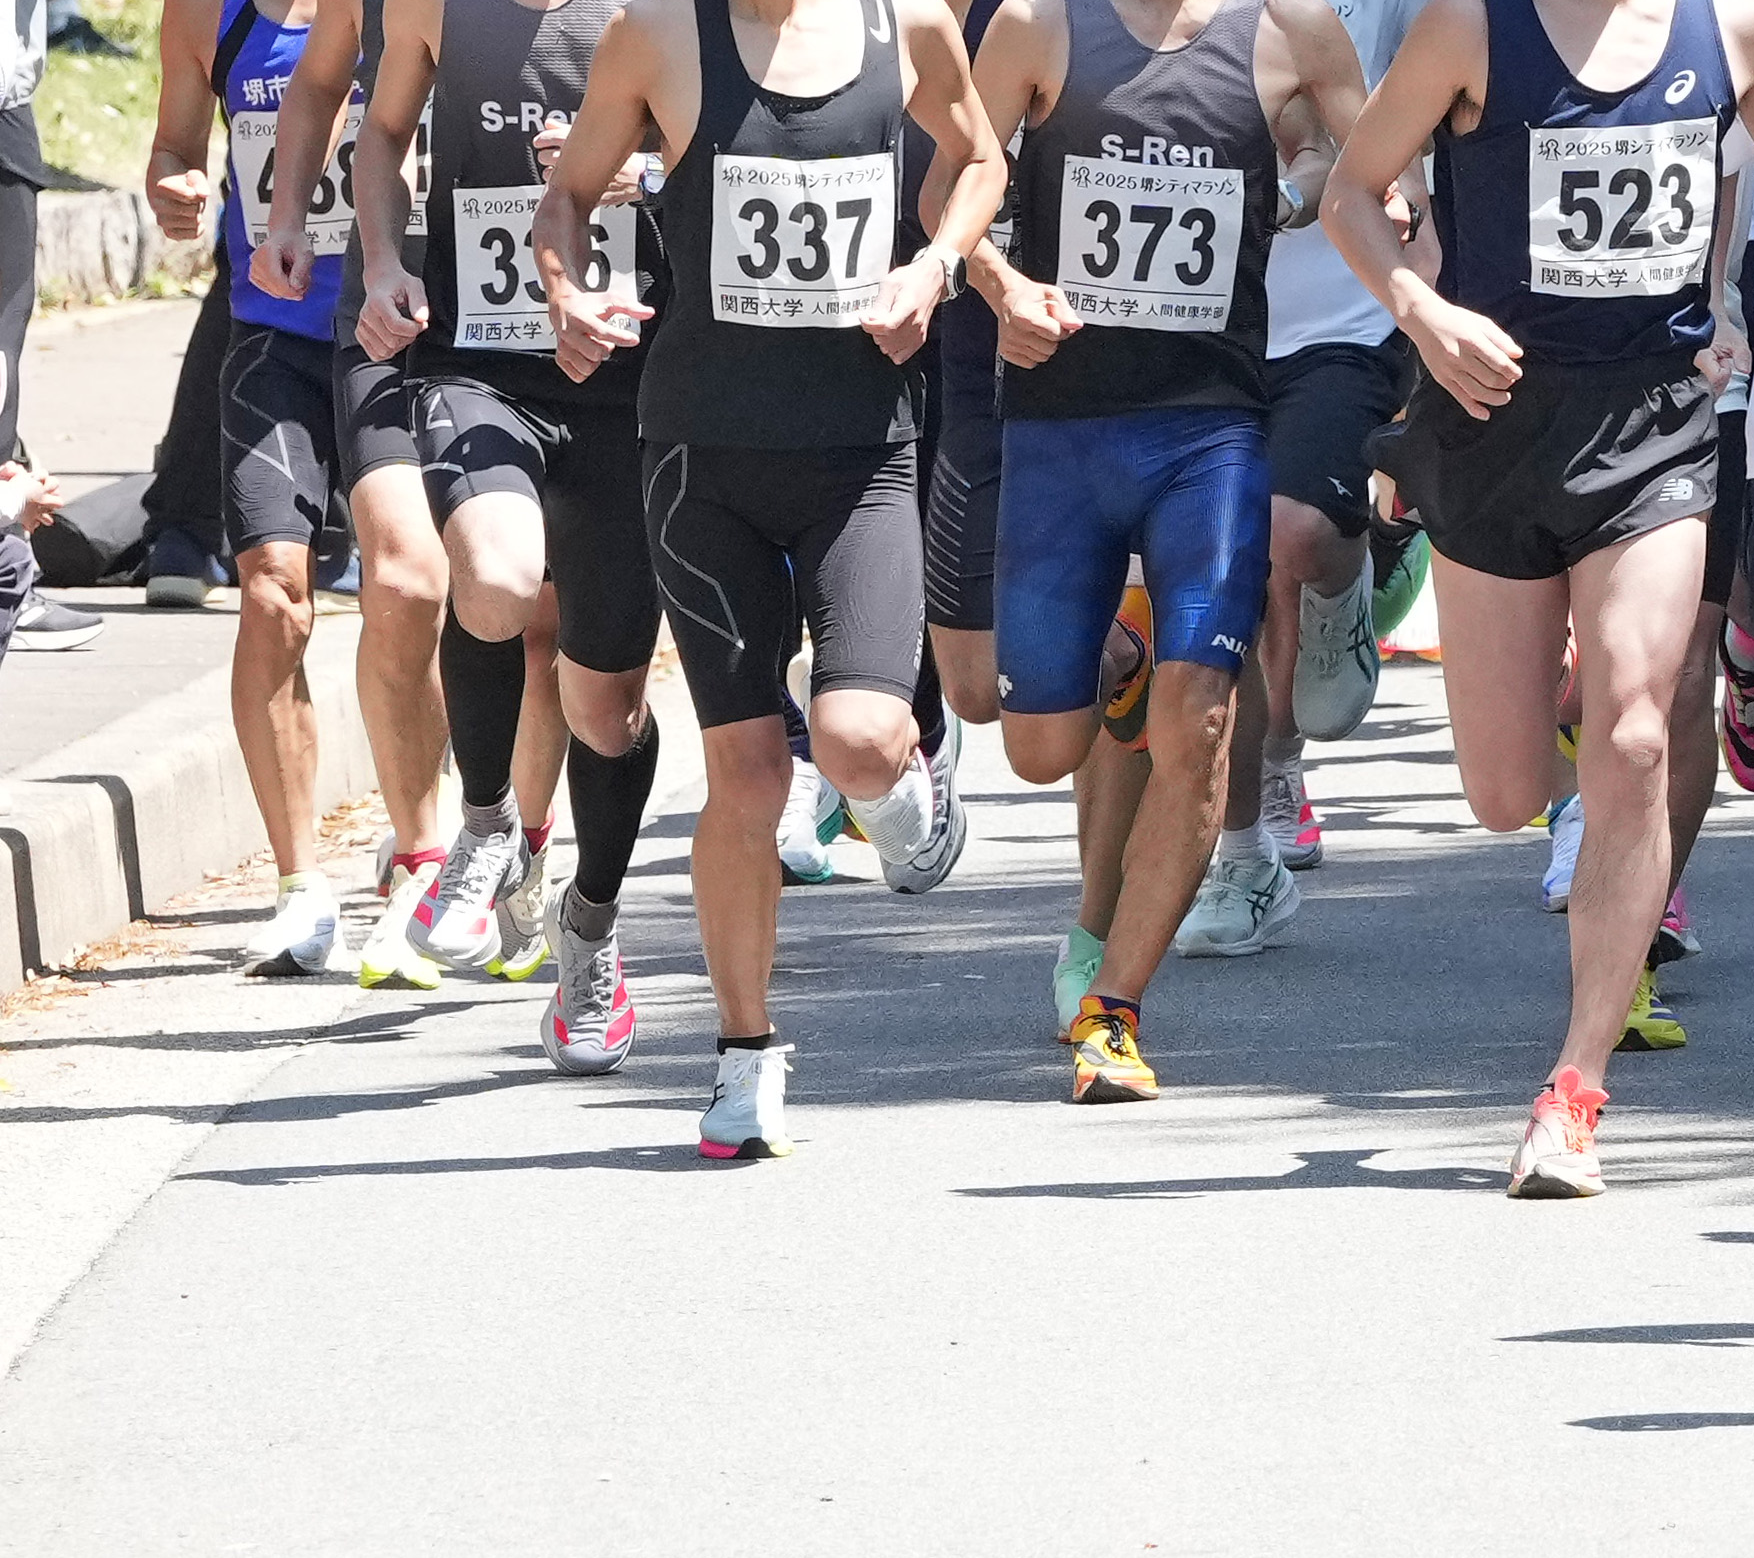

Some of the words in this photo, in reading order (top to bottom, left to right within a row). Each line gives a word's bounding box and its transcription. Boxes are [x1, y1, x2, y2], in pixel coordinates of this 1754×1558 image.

[1100, 133, 1214, 168] S-Ren
[1557, 163, 1694, 252] 523
[736, 198, 872, 282] 337
[1081, 200, 1217, 286] 373
[1540, 267, 1629, 289] 関西大学
[720, 294, 804, 317] 関西大学
[1148, 302, 1225, 319] 人間健康学部
[465, 321, 543, 341] 関西大学
